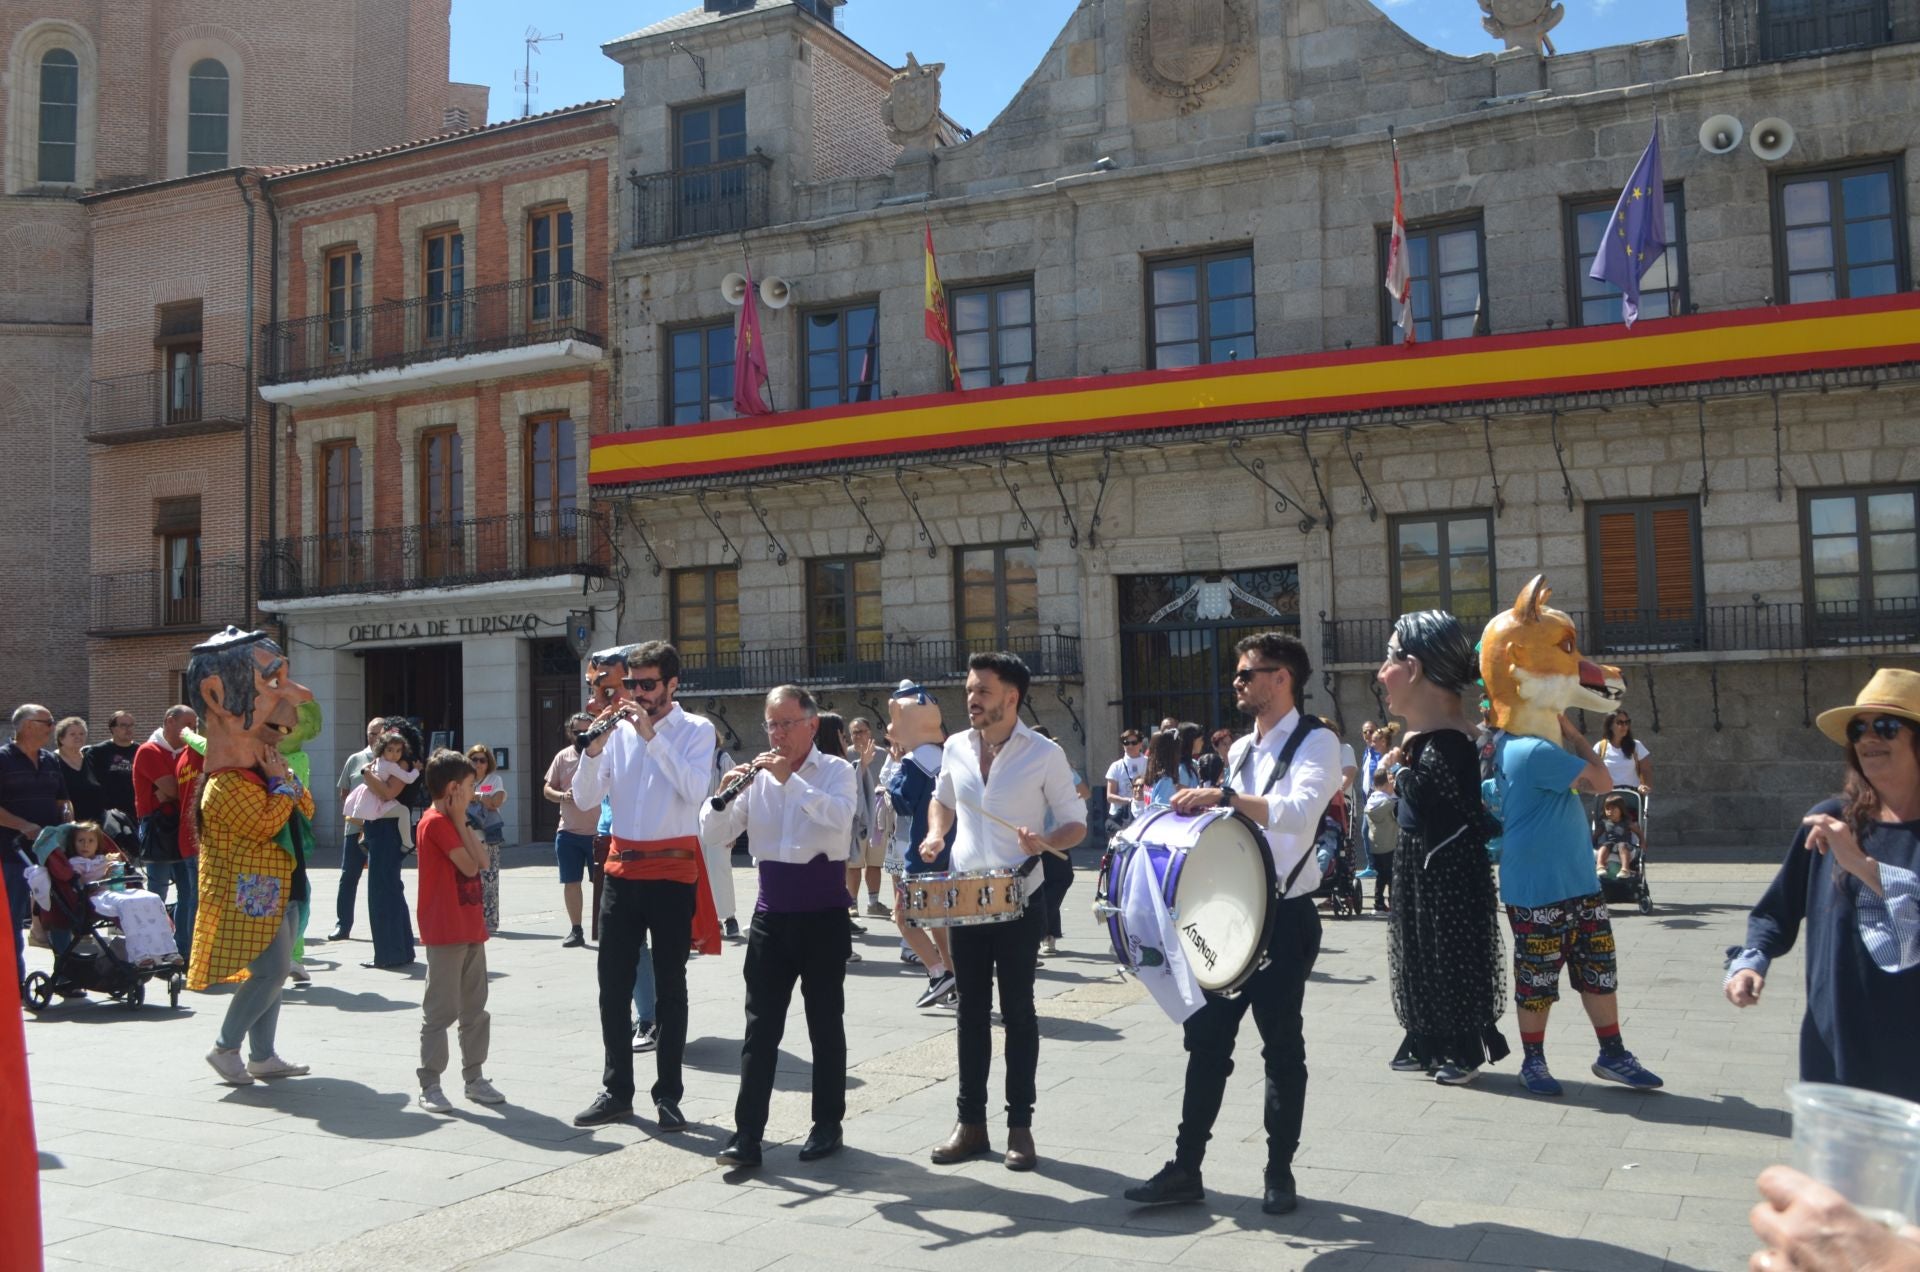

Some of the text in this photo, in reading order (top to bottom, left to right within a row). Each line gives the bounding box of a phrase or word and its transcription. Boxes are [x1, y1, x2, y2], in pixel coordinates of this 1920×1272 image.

[349, 613, 539, 642] OFICINA DE TURISMO
